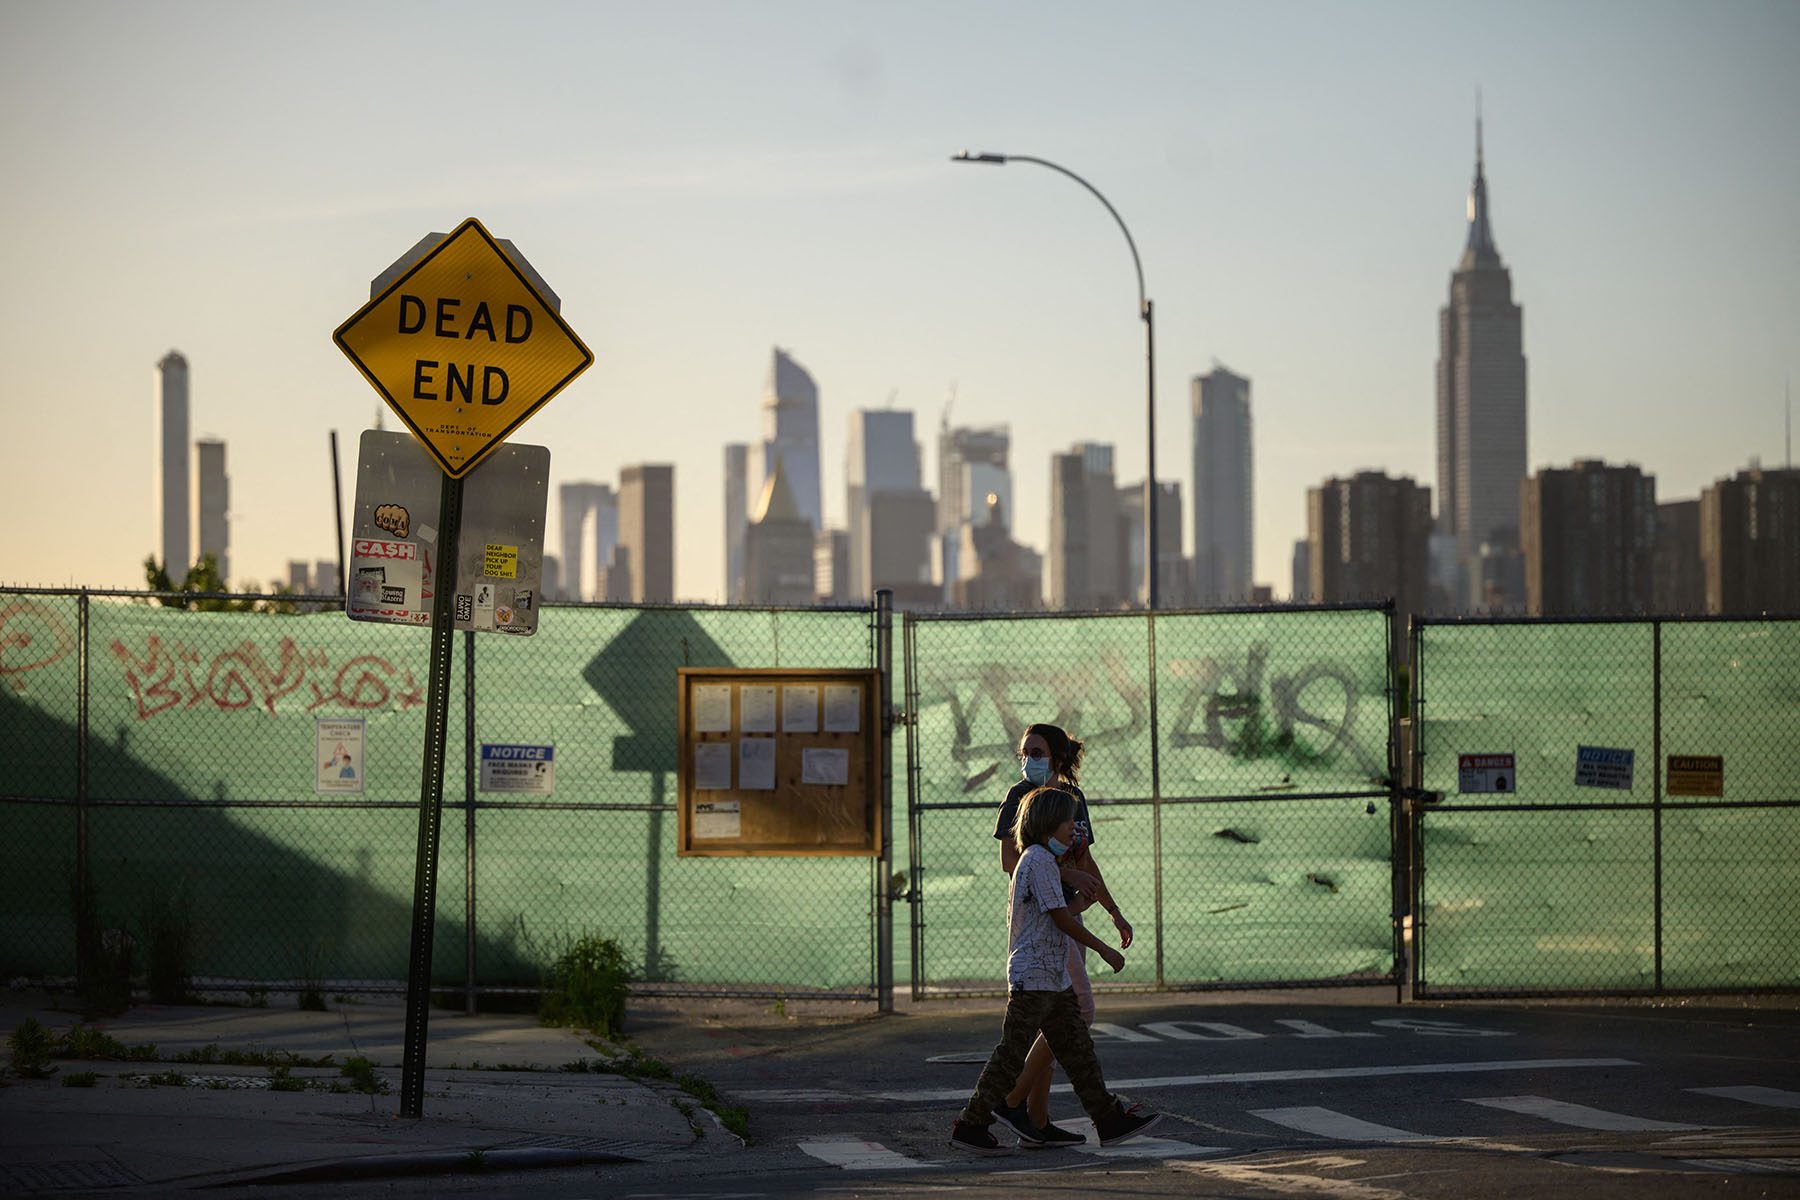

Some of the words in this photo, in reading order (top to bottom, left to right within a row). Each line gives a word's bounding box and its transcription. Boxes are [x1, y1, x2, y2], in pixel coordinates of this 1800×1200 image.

[398, 294, 533, 344] DEAD
[413, 359, 510, 406] END
[425, 427, 492, 438] TRANSPORTATION
[376, 515, 405, 529] COMA
[490, 747, 546, 759] NOTICE
[1582, 750, 1628, 763] NOTICE
[1673, 759, 1719, 769] CAUTION
